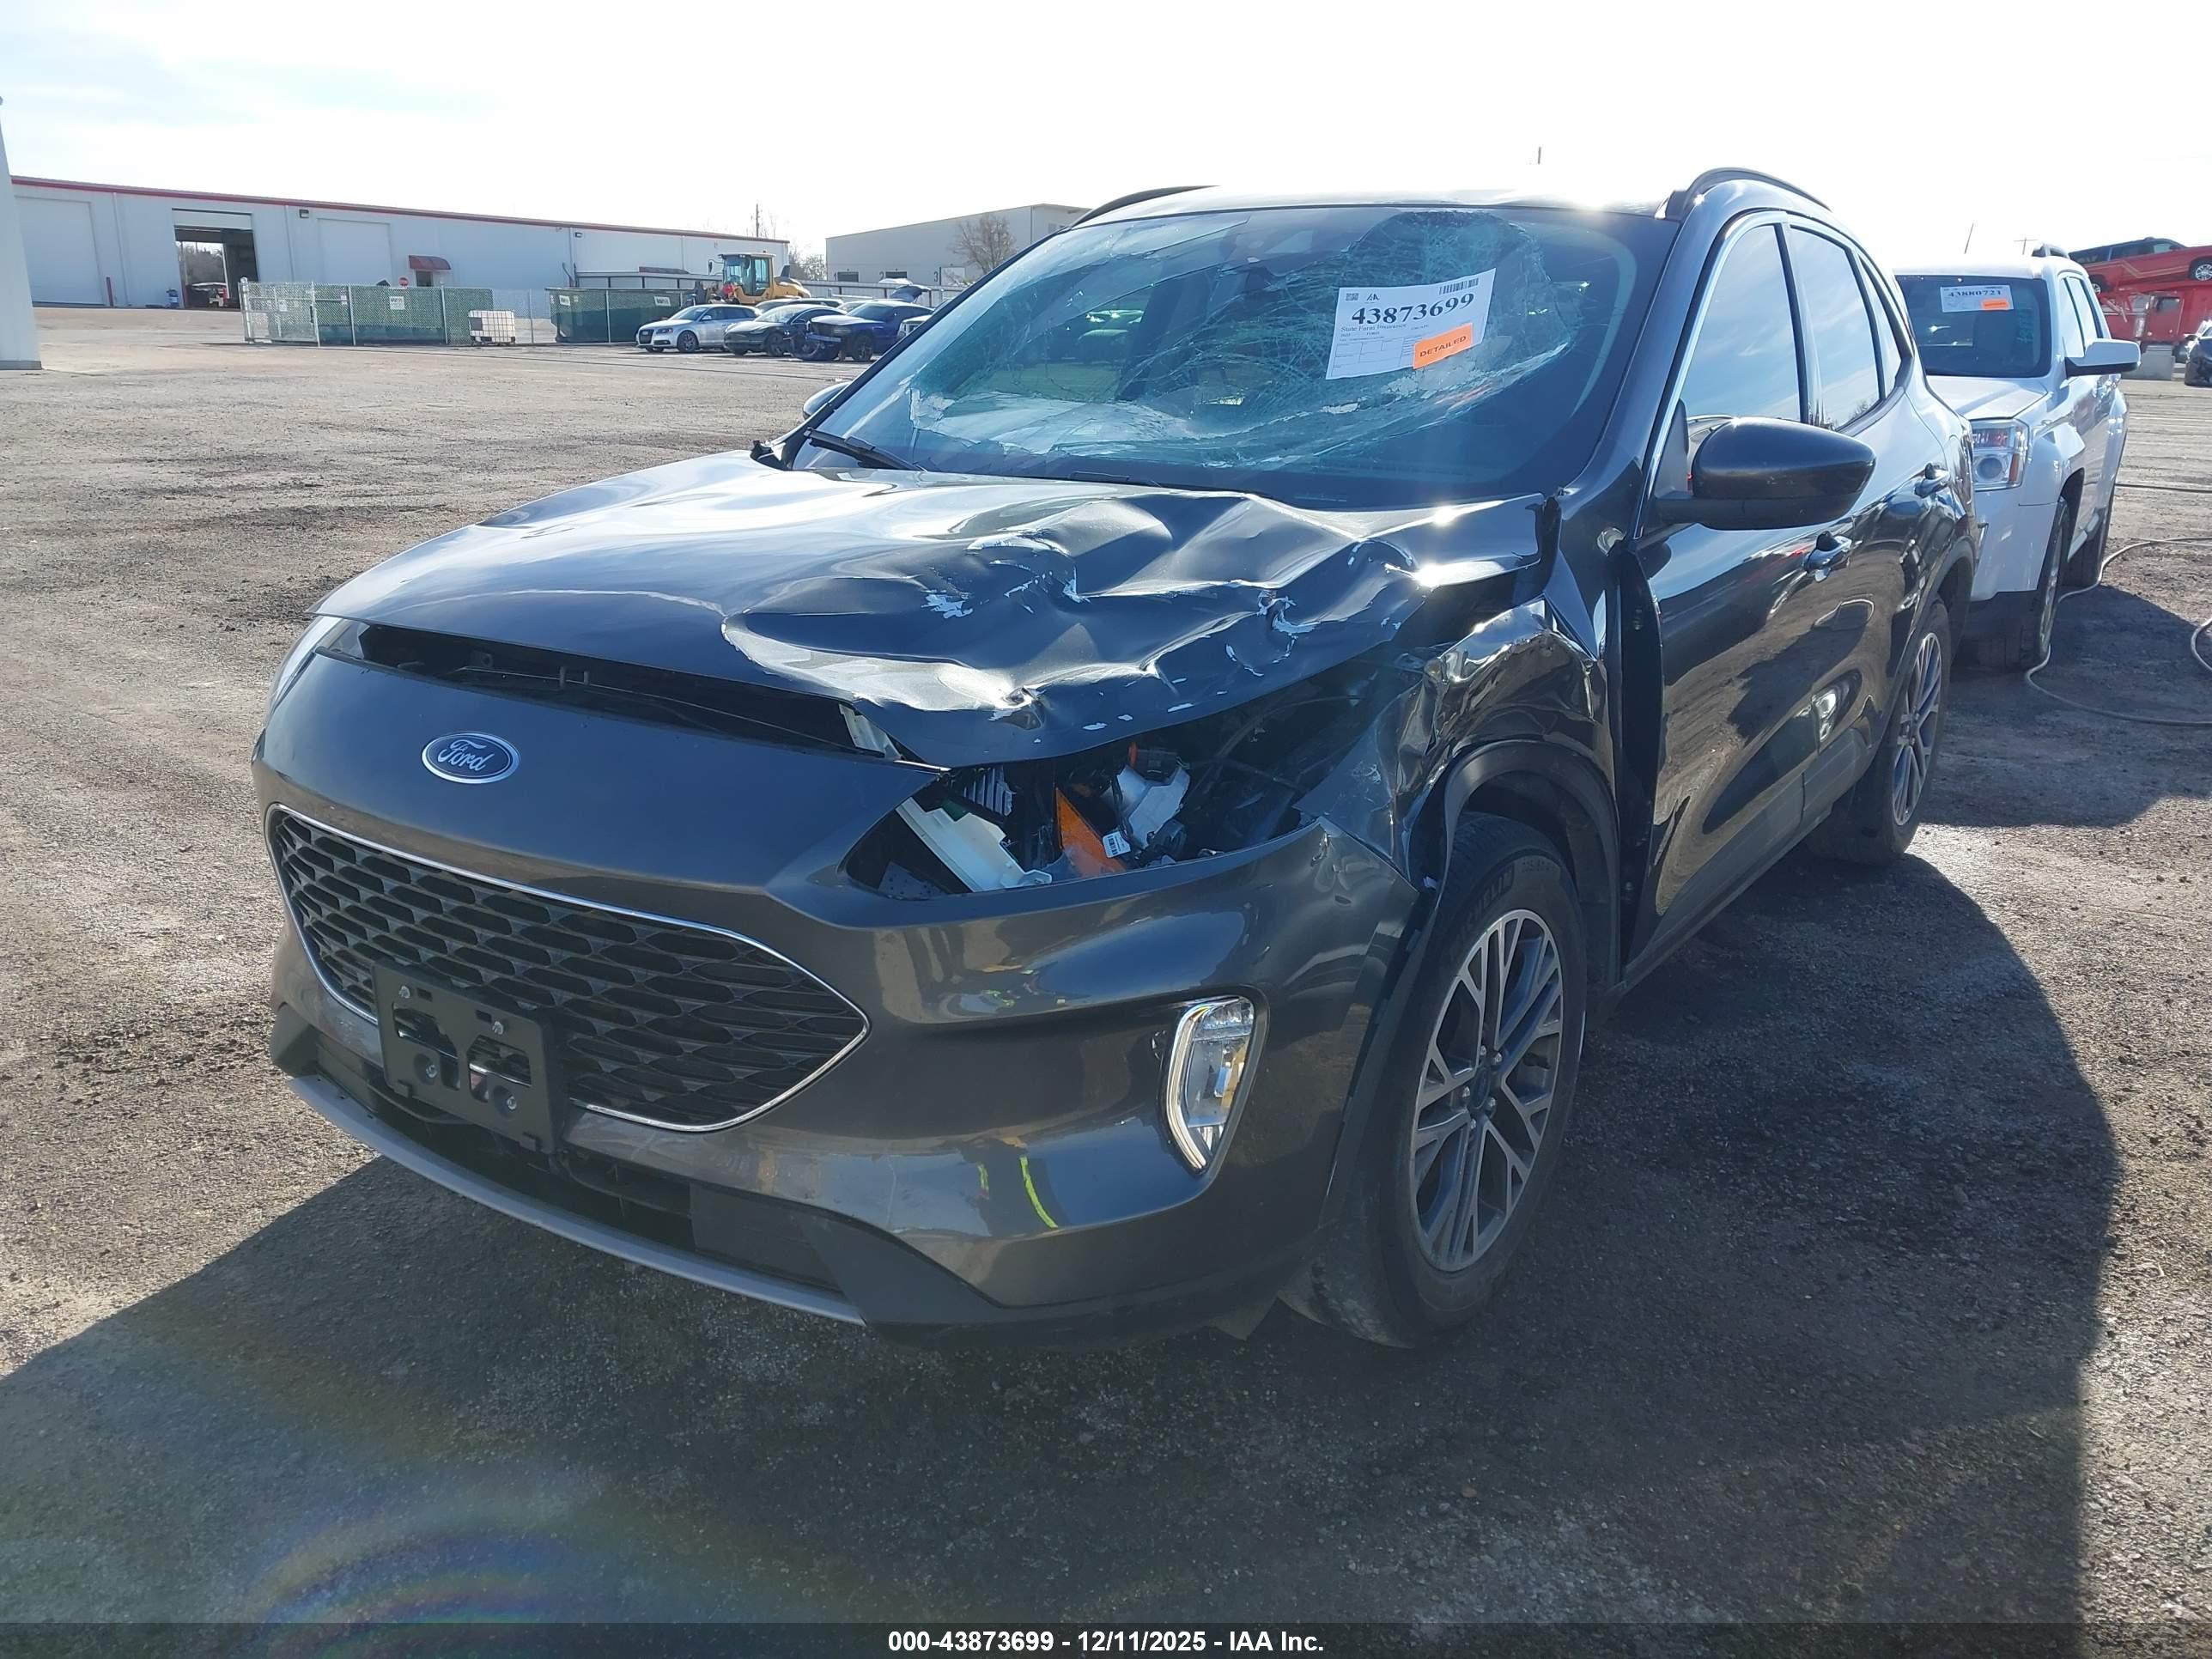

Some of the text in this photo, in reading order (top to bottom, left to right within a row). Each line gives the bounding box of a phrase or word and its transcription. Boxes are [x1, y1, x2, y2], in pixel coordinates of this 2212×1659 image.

[933, 270, 939, 283] 3
[1352, 293, 1474, 325] 43873699
[1419, 336, 1467, 357] DETAILED
[437, 738, 495, 771] Ford
